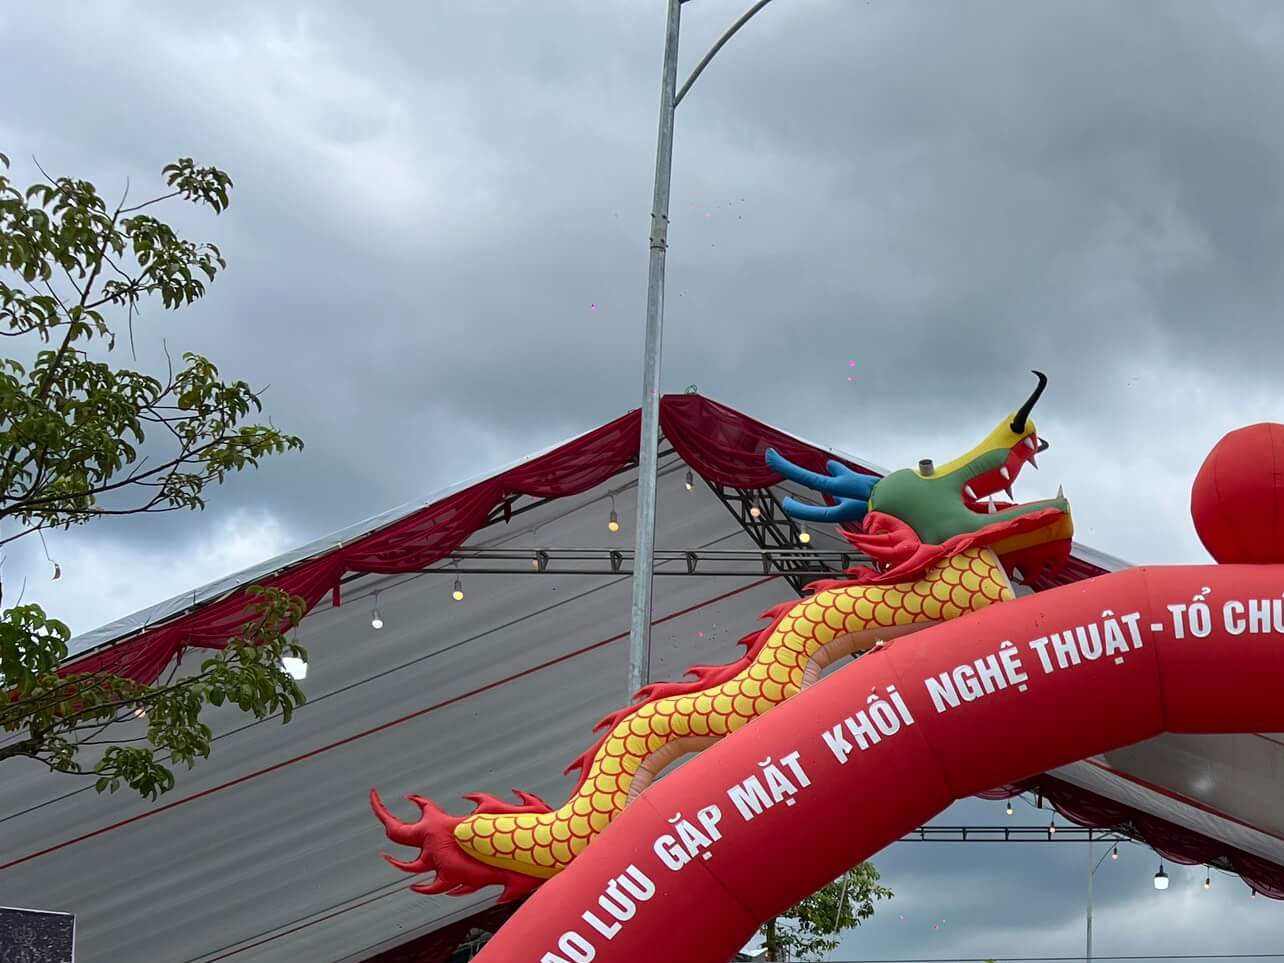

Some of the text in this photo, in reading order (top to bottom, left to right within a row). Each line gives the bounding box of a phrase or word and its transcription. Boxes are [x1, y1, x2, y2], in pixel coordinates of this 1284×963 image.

[582, 864, 656, 940] LƯU
[653, 804, 722, 871] GẶP
[727, 750, 812, 821] MẶT
[924, 640, 1028, 713] NGHỆ
[1029, 609, 1143, 674] THUẬT
[1167, 586, 1212, 639] TỔ
